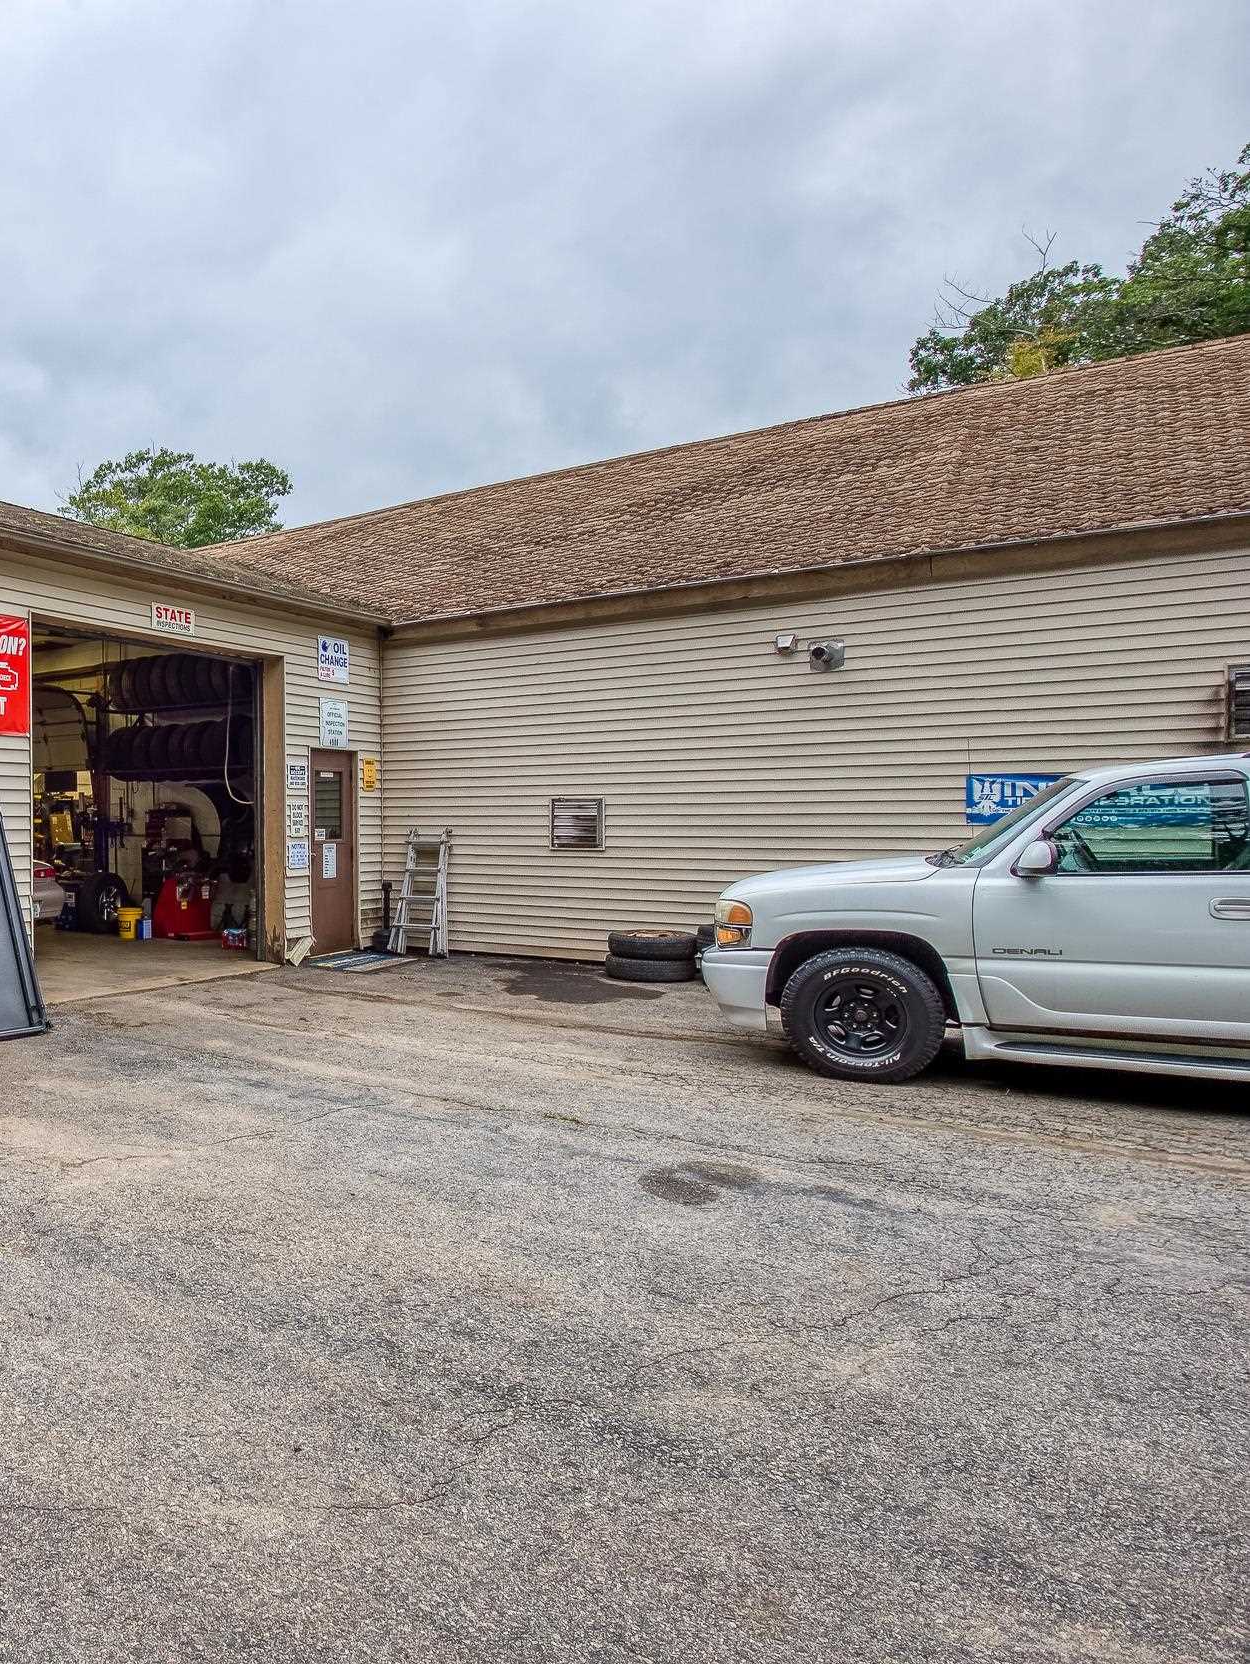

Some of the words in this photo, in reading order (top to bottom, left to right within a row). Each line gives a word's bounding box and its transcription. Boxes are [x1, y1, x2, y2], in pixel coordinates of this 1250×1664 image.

[155, 606, 191, 625] STATE
[156, 620, 191, 632] INSPECTIONS
[333, 642, 347, 655] OIL
[320, 653, 348, 669] CHANGE
[992, 948, 1063, 956] DENALI
[823, 966, 908, 993] BFGoodrich
